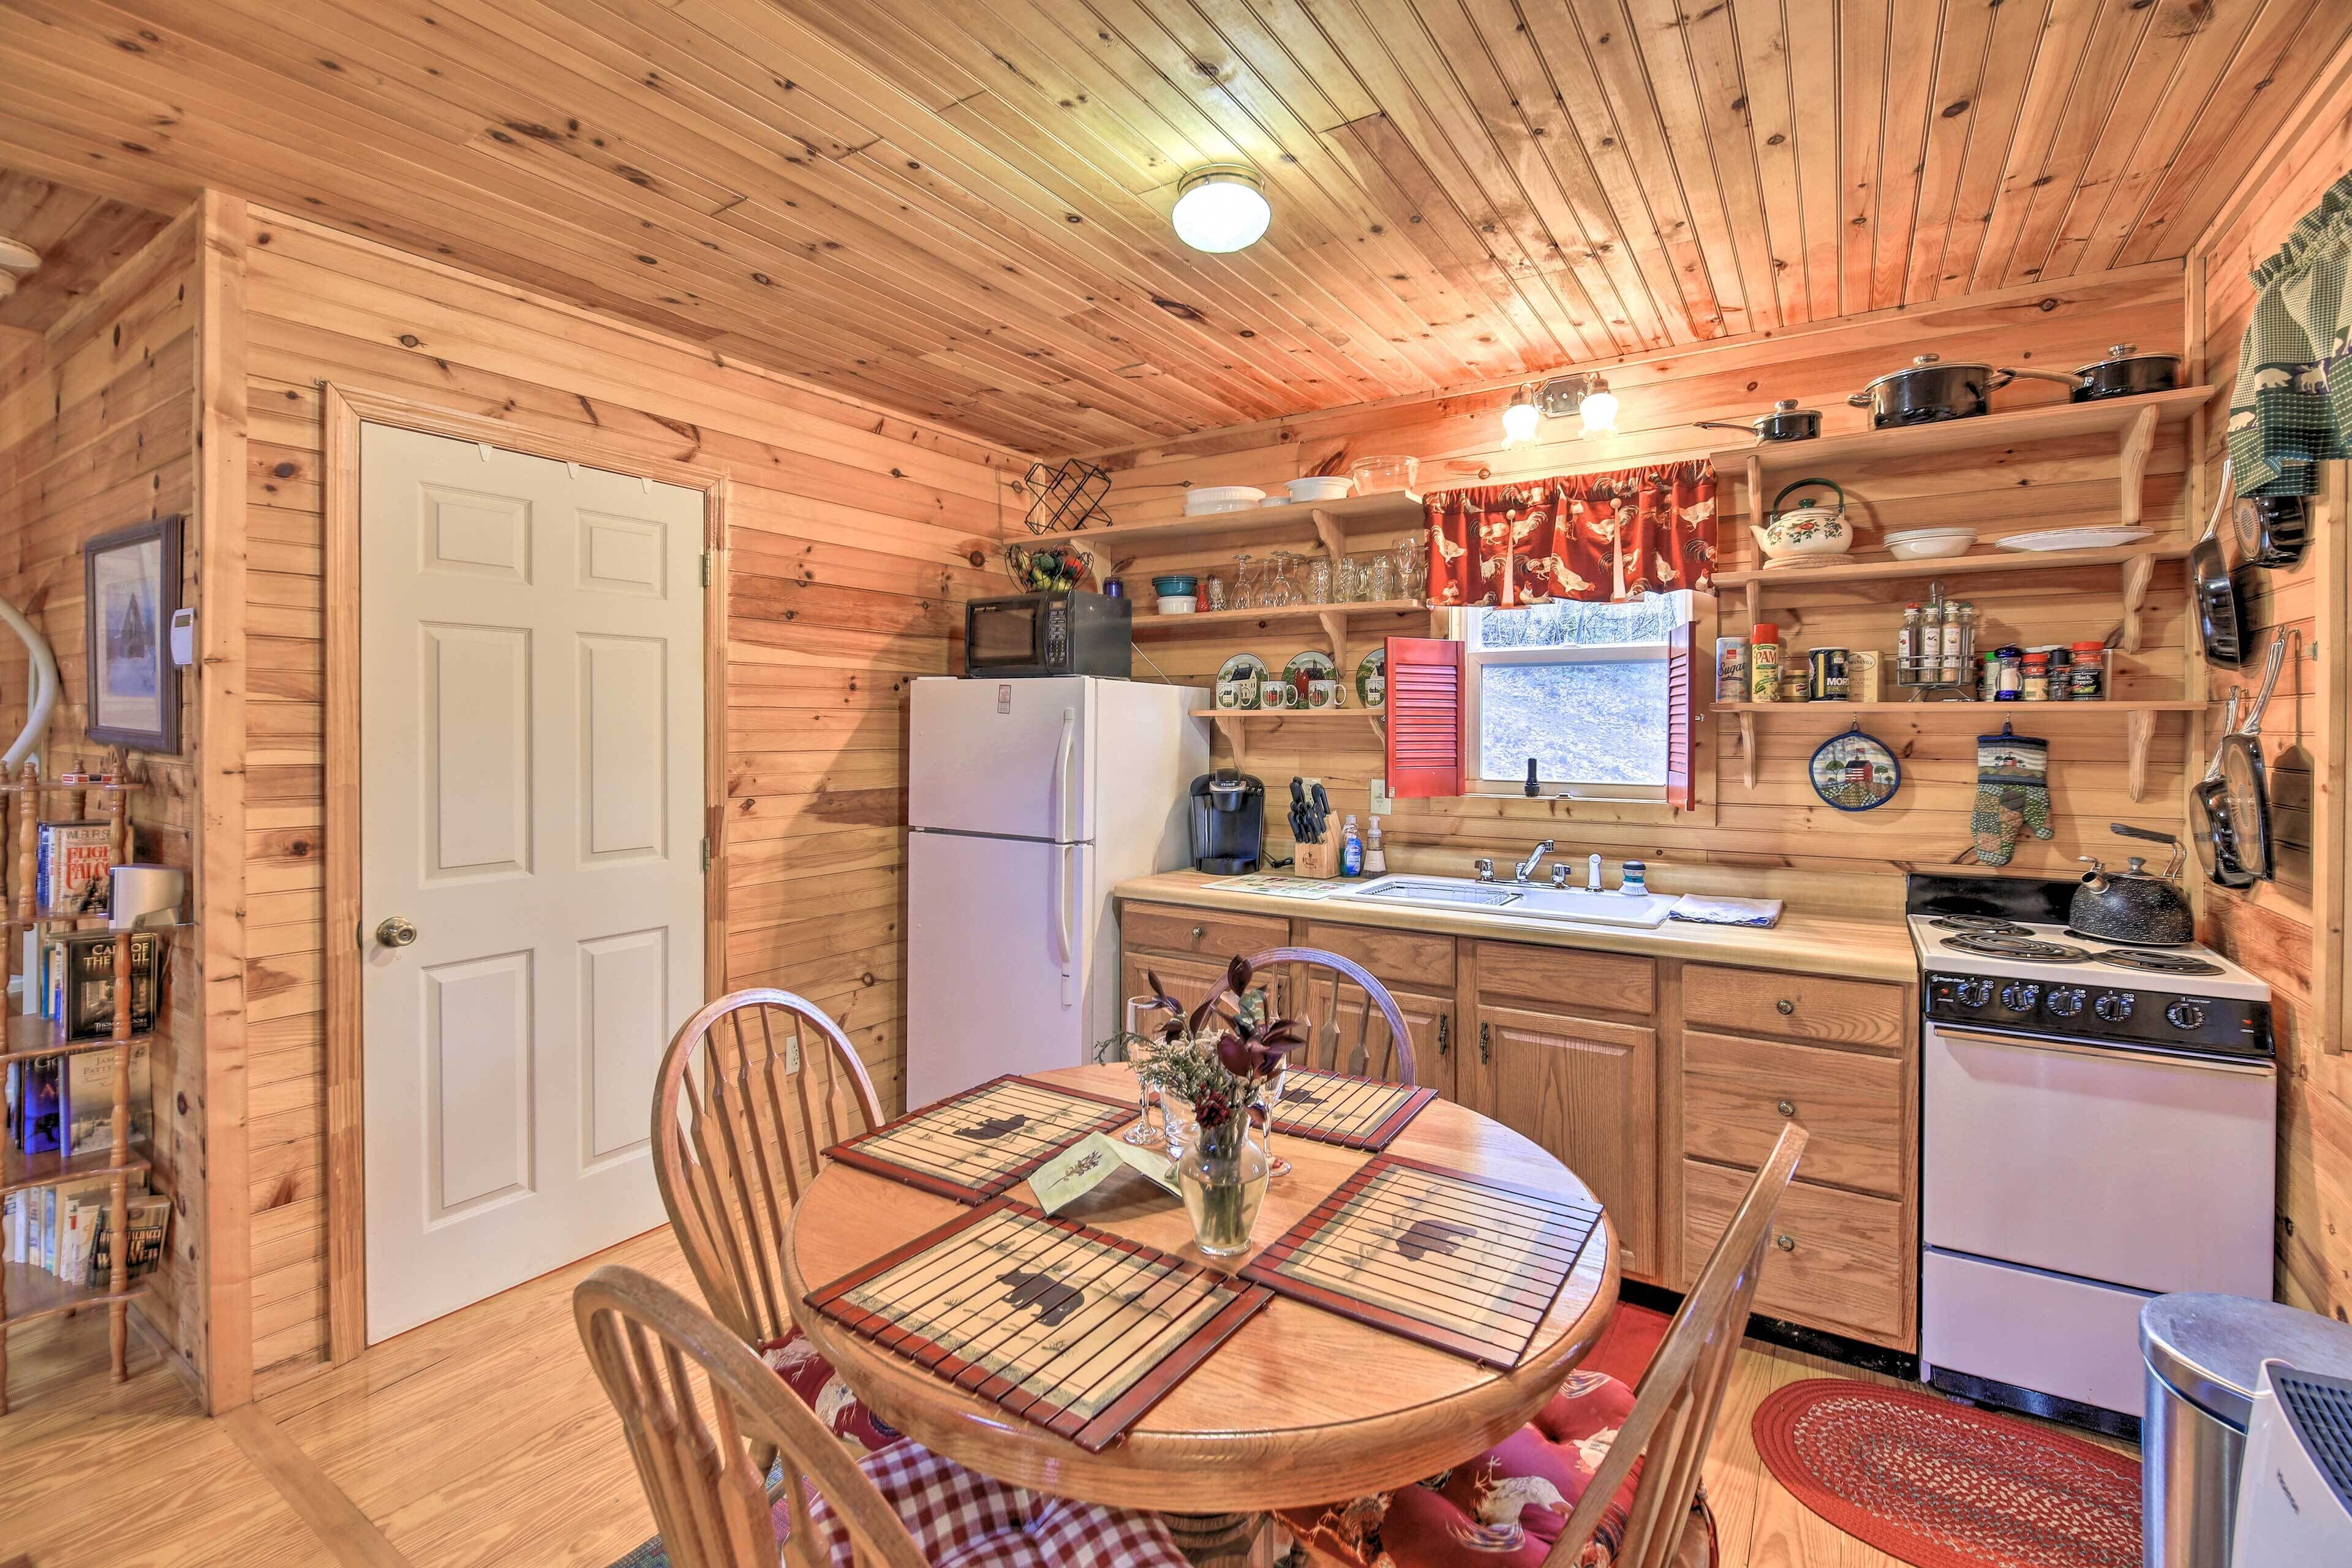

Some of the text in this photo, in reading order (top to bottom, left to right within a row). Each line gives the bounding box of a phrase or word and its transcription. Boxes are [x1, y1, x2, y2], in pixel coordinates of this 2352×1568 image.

[1755, 650, 1776, 665] PAM
[1717, 662, 1746, 677] Sugar
[66, 830, 99, 839] WILBUR
[66, 846, 108, 862] FLIG
[66, 862, 110, 890] FALC
[131, 943, 149, 952] OF
[83, 953, 149, 967] THE UL
